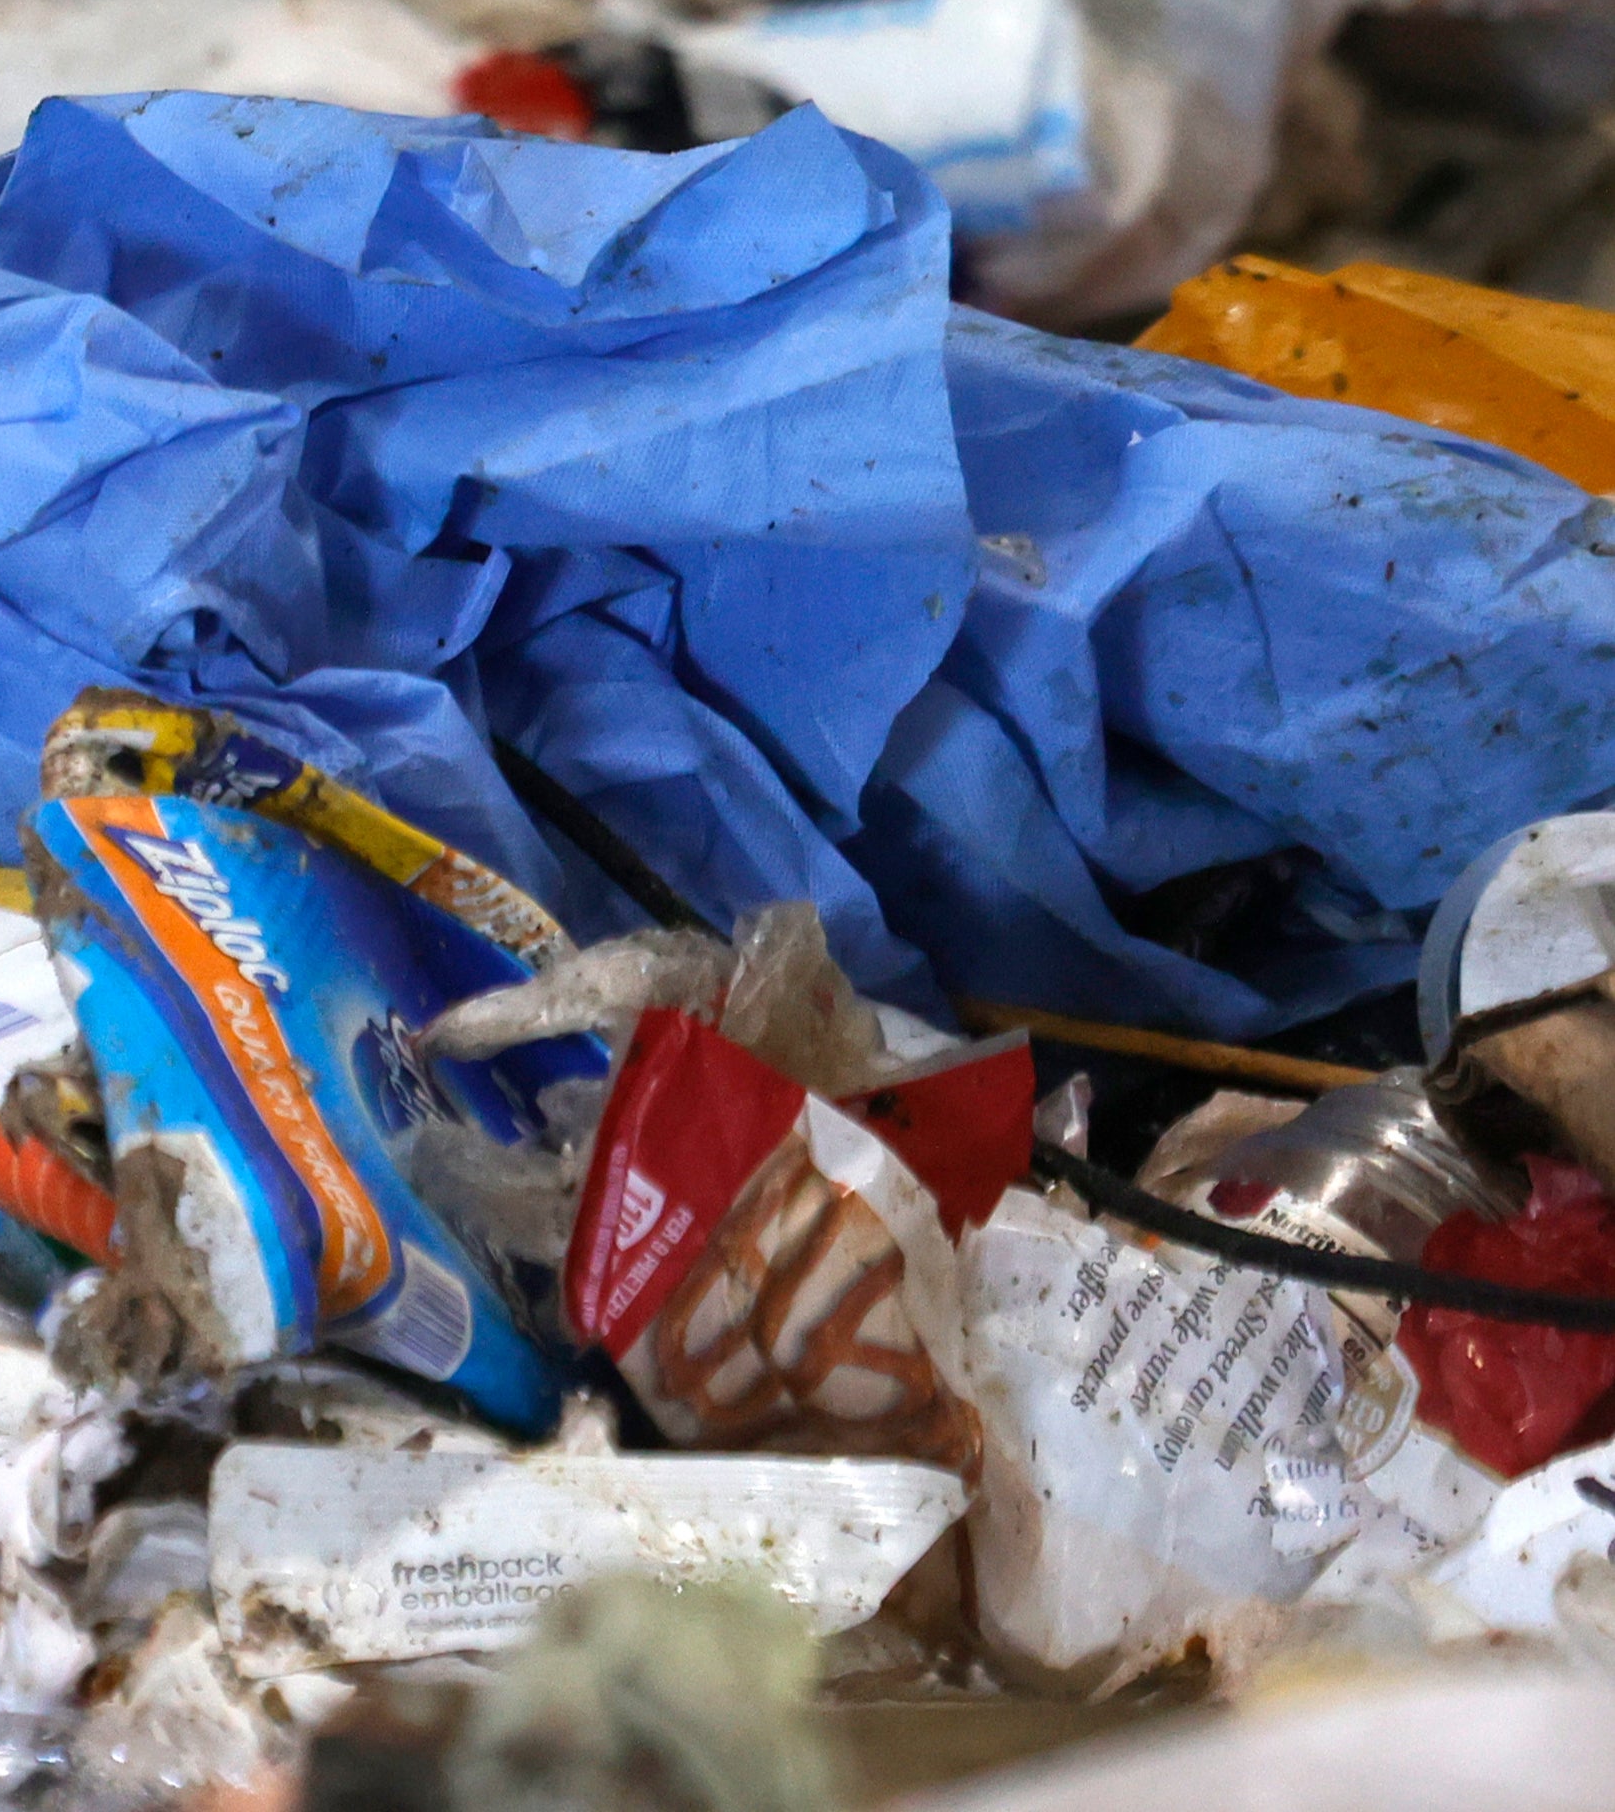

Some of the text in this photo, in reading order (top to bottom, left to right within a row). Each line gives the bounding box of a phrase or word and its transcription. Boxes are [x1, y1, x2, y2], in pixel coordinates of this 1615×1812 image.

[125, 837, 289, 992] Ziploc
[1059, 1262, 1109, 1323] offer.
[1171, 1286, 1218, 1344] wide
[1208, 1302, 1268, 1384] Street
[391, 1552, 564, 1586] freshpack
